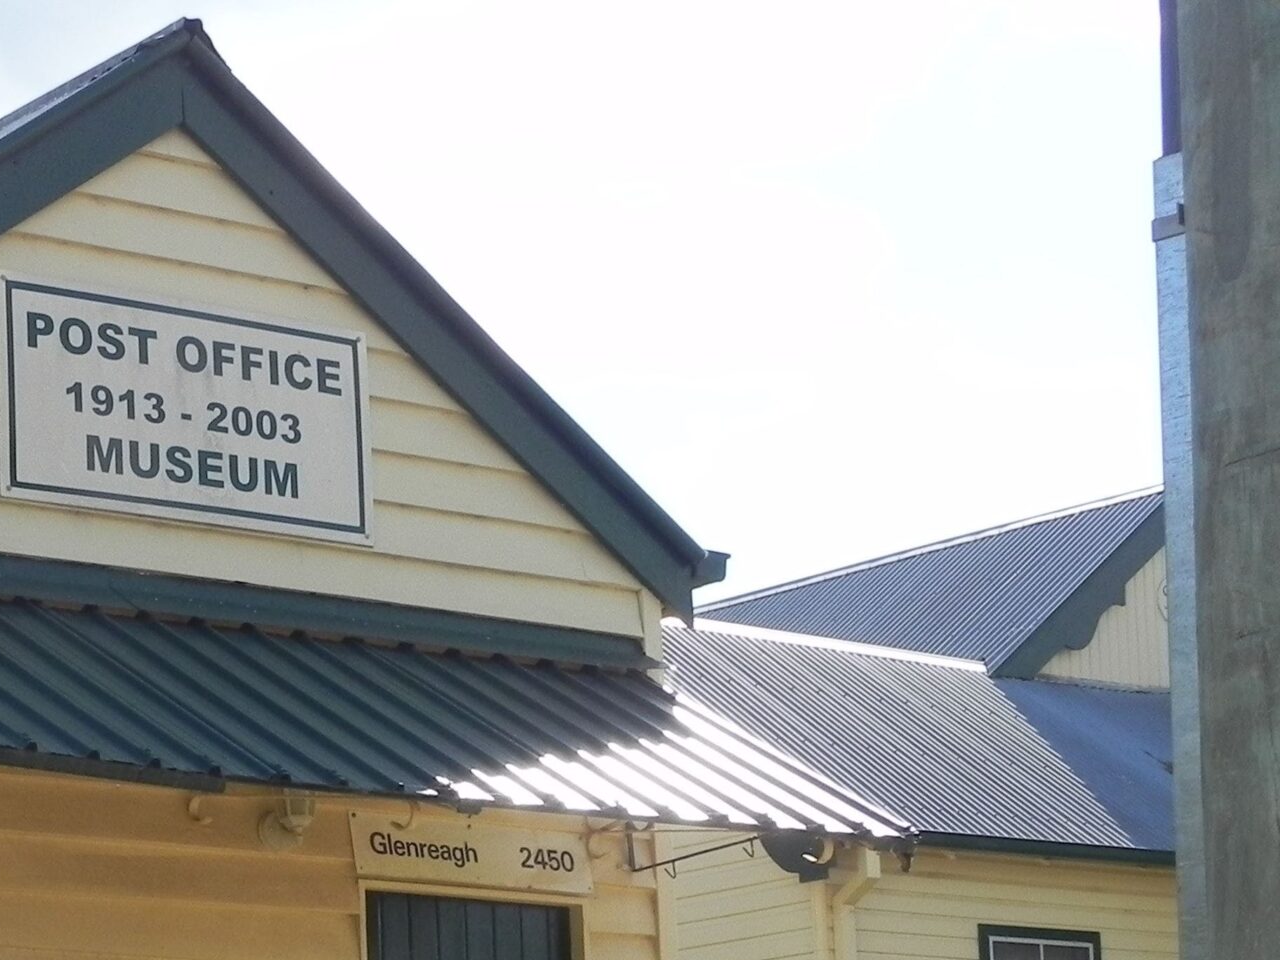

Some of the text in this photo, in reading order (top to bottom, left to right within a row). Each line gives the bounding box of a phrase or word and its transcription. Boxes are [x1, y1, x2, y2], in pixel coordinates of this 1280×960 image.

[26, 311, 342, 397] POST OFFICE
[65, 382, 302, 444] 1913 - 2003
[86, 435, 299, 499] MUSEUM
[370, 832, 575, 872] Glenreagh 2450
